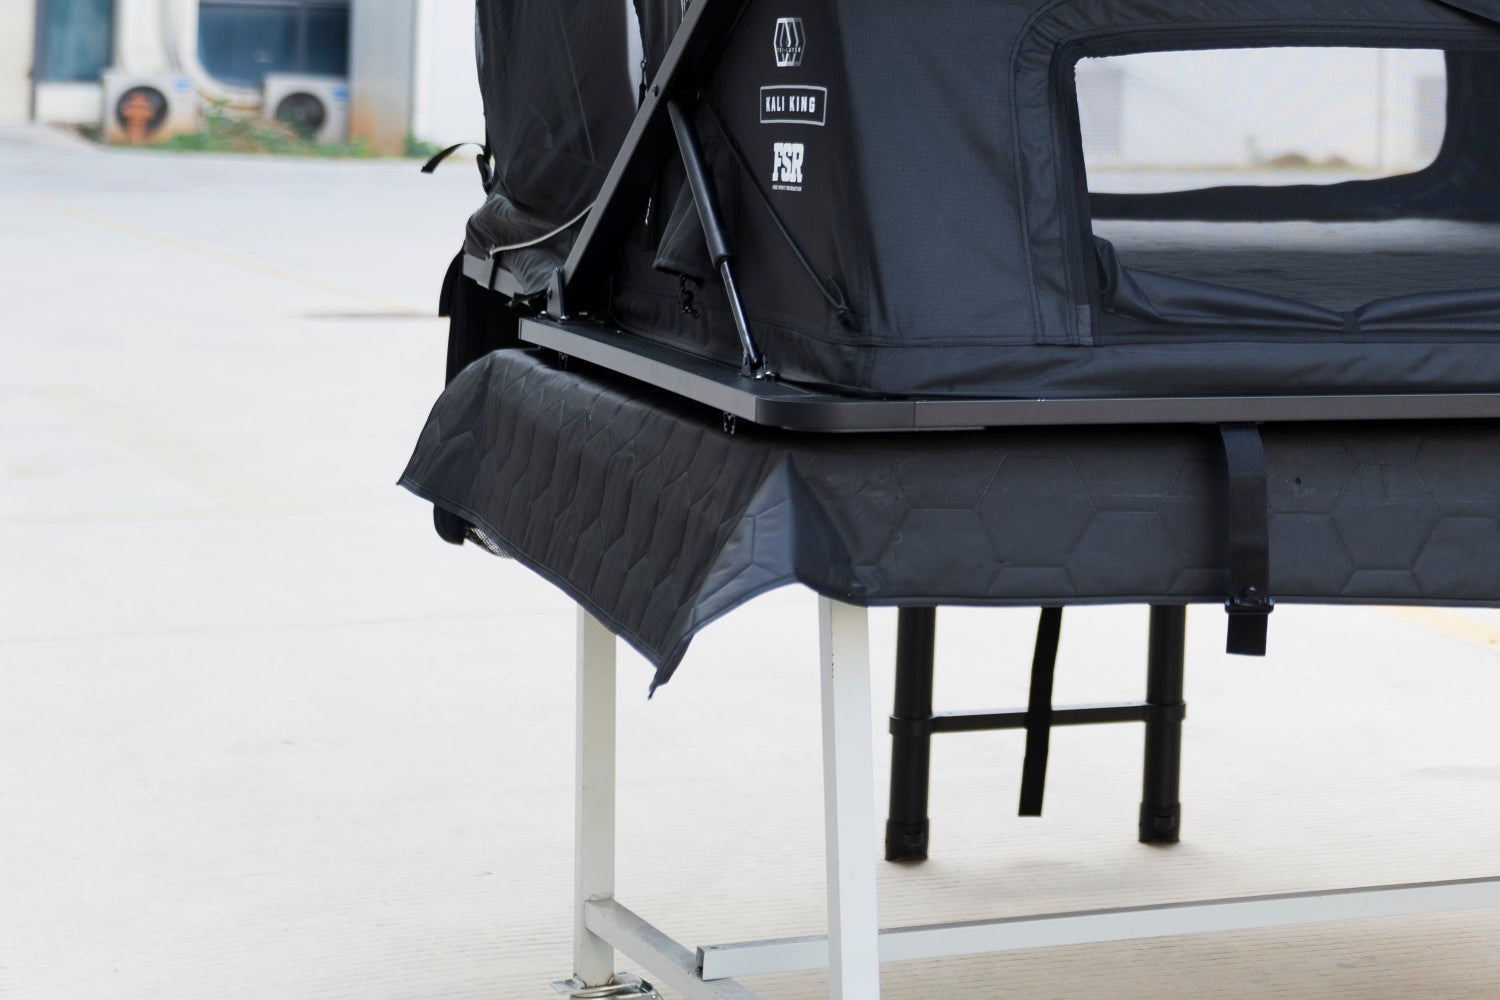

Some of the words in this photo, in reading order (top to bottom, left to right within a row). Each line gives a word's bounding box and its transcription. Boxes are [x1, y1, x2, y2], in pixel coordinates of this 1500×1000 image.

[765, 96, 785, 112] KALI
[789, 96, 816, 113] KING
[772, 142, 805, 183] FSR
